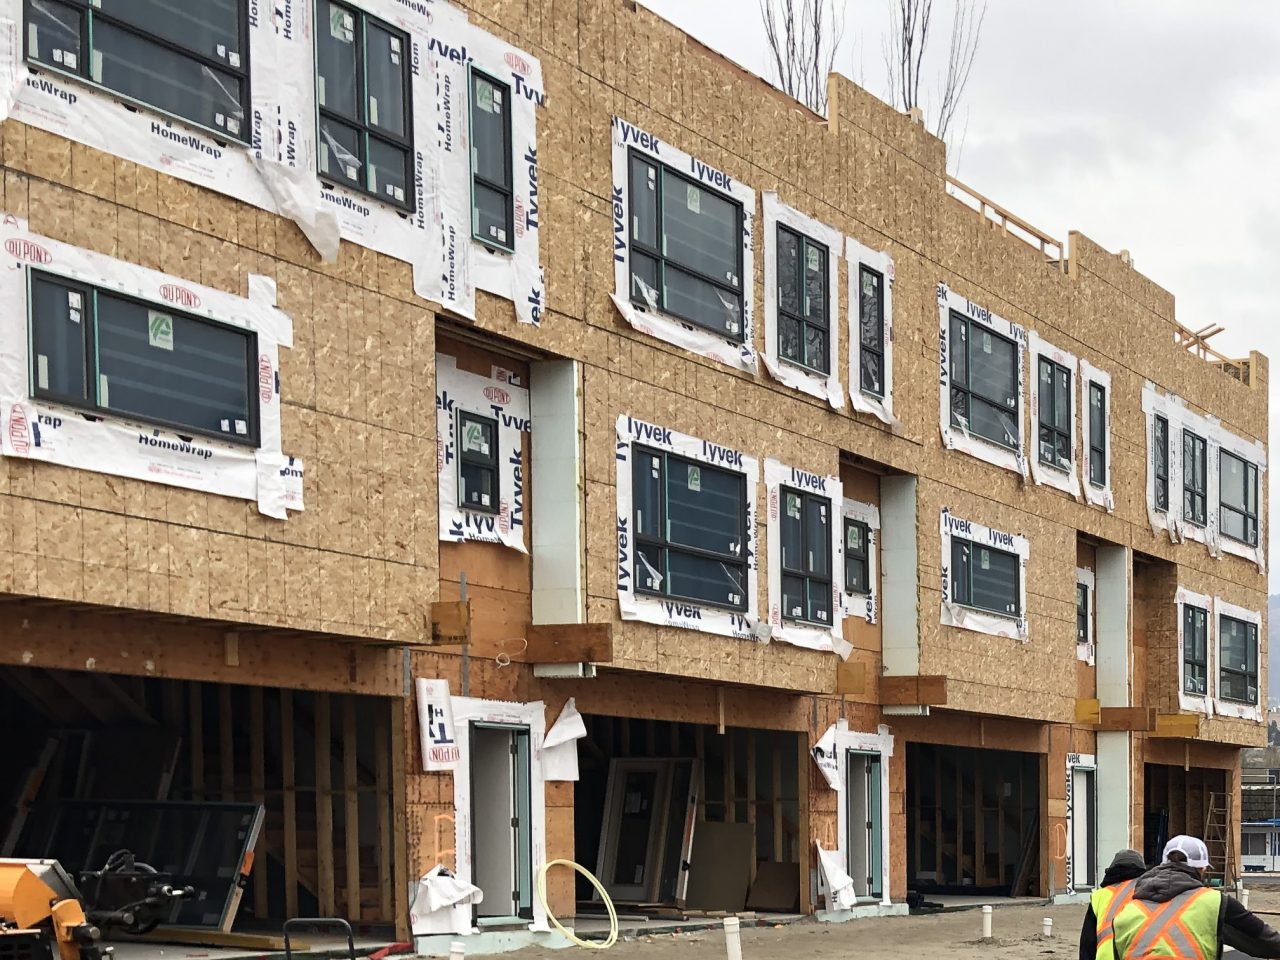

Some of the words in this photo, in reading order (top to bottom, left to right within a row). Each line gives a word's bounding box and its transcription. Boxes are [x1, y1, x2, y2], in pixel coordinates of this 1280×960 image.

[151, 121, 222, 159] HomeWrap
[416, 152, 424, 229] HomeWrap
[447, 225, 456, 301] HomeWrap
[138, 434, 213, 460] HomeWrap
[510, 448, 523, 530] Tyvek
